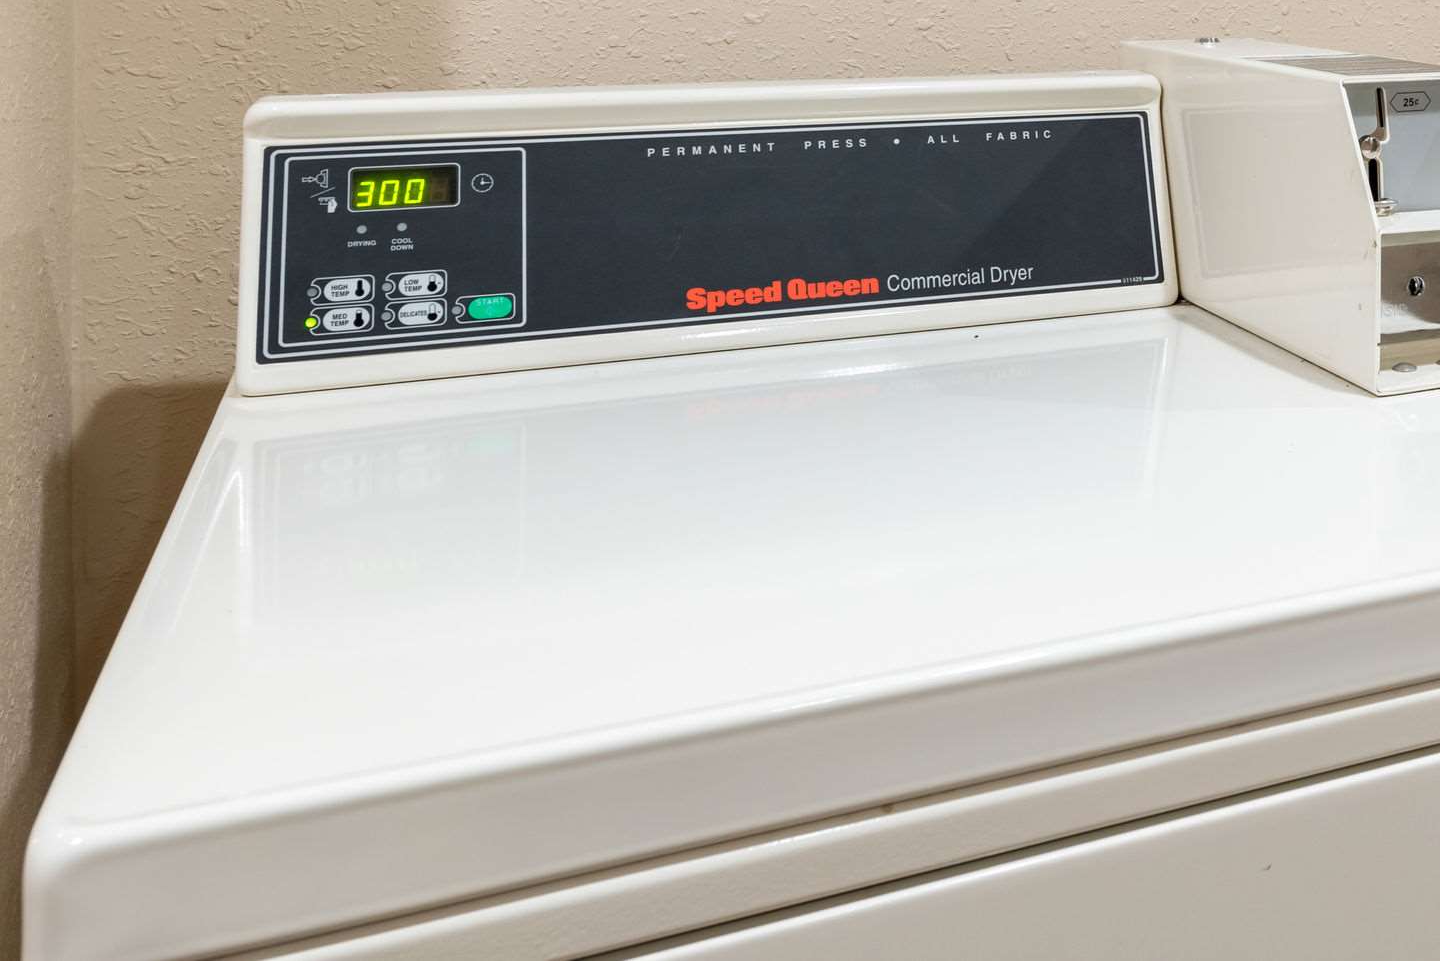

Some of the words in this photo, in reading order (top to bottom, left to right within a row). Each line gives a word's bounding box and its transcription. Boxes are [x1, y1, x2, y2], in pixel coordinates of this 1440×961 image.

[647, 142, 776, 158] PERMANENT
[804, 138, 867, 150] PRESS
[927, 134, 960, 145] ALL
[985, 129, 1052, 142] FABRIC
[356, 178, 426, 208] 300
[347, 239, 377, 248] DRYING
[391, 237, 413, 245] COOL
[404, 284, 422, 292] TEMP
[686, 280, 782, 313] Speed
[787, 277, 880, 301] Queen
[887, 268, 985, 292] Commercial
[991, 264, 1035, 287] Dryer
[331, 290, 350, 298] TEMP
